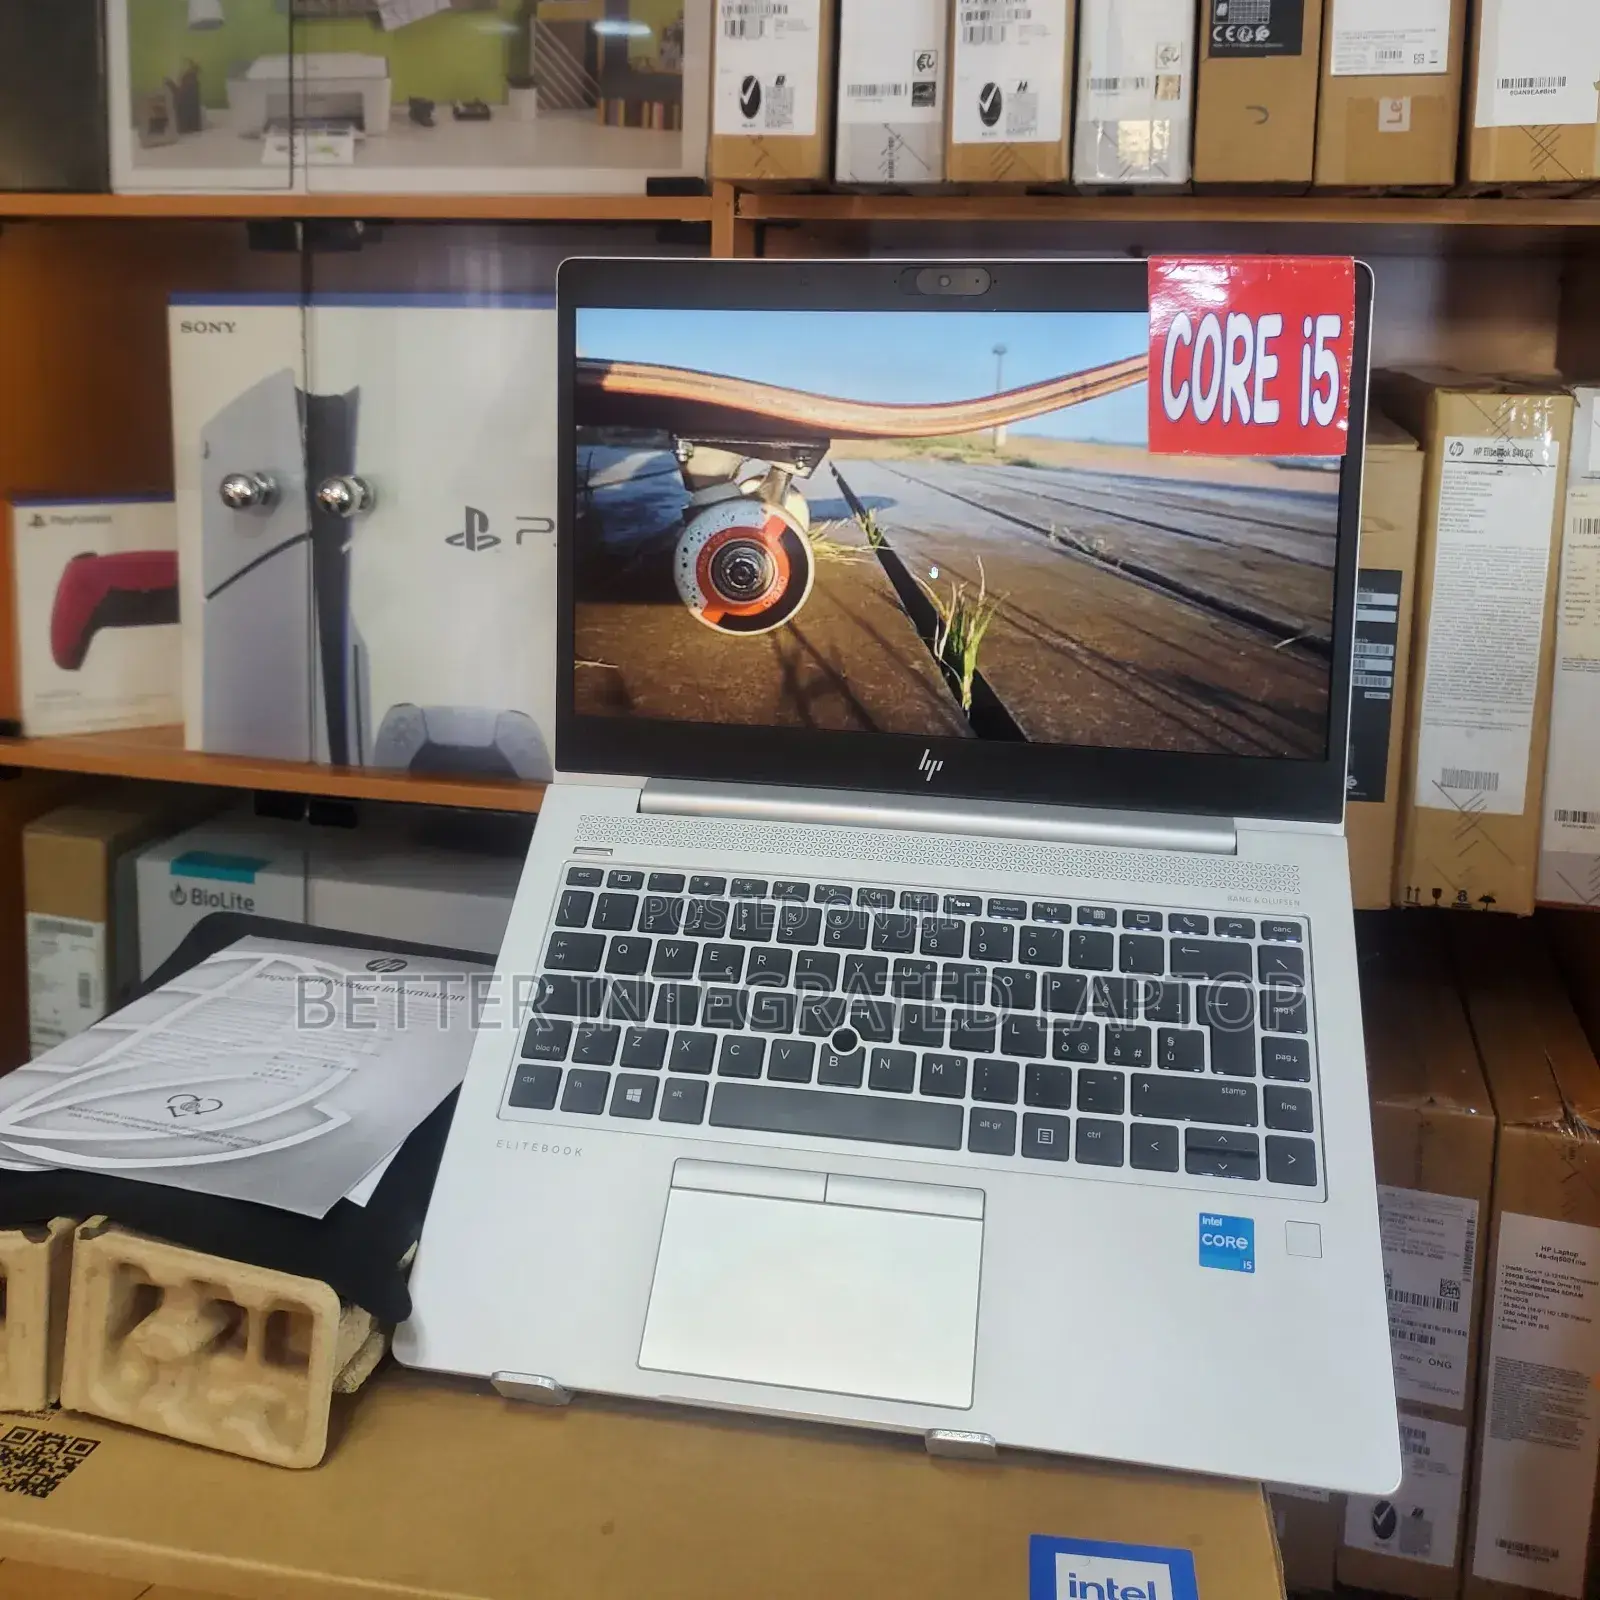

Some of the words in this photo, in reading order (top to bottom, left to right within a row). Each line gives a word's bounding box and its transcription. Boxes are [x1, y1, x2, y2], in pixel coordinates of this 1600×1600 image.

[180, 321, 236, 334] SONY
[1162, 311, 1283, 425] CORE
[1300, 314, 1342, 427] i5
[191, 888, 254, 912] BioLite
[1262, 897, 1300, 906] OLUFSEN
[601, 913, 606, 922] 1
[741, 908, 748, 918] $
[788, 913, 797, 922] %
[647, 916, 654, 925] 2
[692, 920, 700, 928] 3
[835, 915, 843, 925] &
[738, 924, 746, 932] 4
[786, 928, 793, 936] 5
[832, 931, 840, 939] 6
[881, 934, 889, 944] 7
[1079, 935, 1086, 944] ?
[930, 939, 937, 947] 8
[979, 943, 987, 952] 9
[618, 944, 628, 955] Q
[665, 948, 679, 958] W
[1028, 947, 1037, 956] 0
[710, 951, 719, 961] E
[757, 955, 766, 965] R
[805, 959, 813, 968] T
[854, 963, 864, 972] Y
[903, 967, 912, 977] U
[1025, 972, 1030, 980] 6
[1002, 976, 1013, 987] O
[1052, 981, 1061, 991] P
[382, 985, 466, 1002] Information
[619, 989, 629, 999] A
[667, 992, 675, 1002] S
[713, 997, 724, 1007] D
[761, 1001, 770, 1010] F
[812, 1004, 822, 1015] G
[860, 1010, 870, 1020] H
[910, 1014, 918, 1024] J
[960, 1019, 969, 1030] K
[1012, 1024, 1020, 1035] L
[632, 1037, 643, 1047] Z
[680, 1041, 692, 1051] X
[1167, 1036, 1175, 1046] §
[536, 1044, 550, 1052] bloc
[552, 1045, 560, 1053] fn
[730, 1046, 740, 1056] C
[1062, 1043, 1070, 1051] ò
[1078, 1042, 1089, 1053] @
[1114, 1047, 1121, 1056] à
[780, 1049, 790, 1060] V
[1134, 1050, 1142, 1058] #
[1168, 1052, 1174, 1061] ù
[1275, 1053, 1291, 1062] pag
[829, 1056, 839, 1067] B
[880, 1059, 891, 1070] N
[932, 1064, 944, 1075] M
[574, 1080, 582, 1088] fn
[672, 1089, 682, 1098] alt
[1221, 1087, 1246, 1096] stamp
[1281, 1102, 1297, 1111] fine
[980, 1120, 990, 1128] alt
[992, 1122, 1001, 1130] gr
[1087, 1130, 1101, 1138] ctrl
[496, 1139, 583, 1156] ELITEBOOK
[1554, 1247, 1579, 1258] Laptop
[1243, 1260, 1252, 1270] i5
[1428, 1358, 1452, 1369] ONG
[1068, 1572, 1156, 1600] intel
